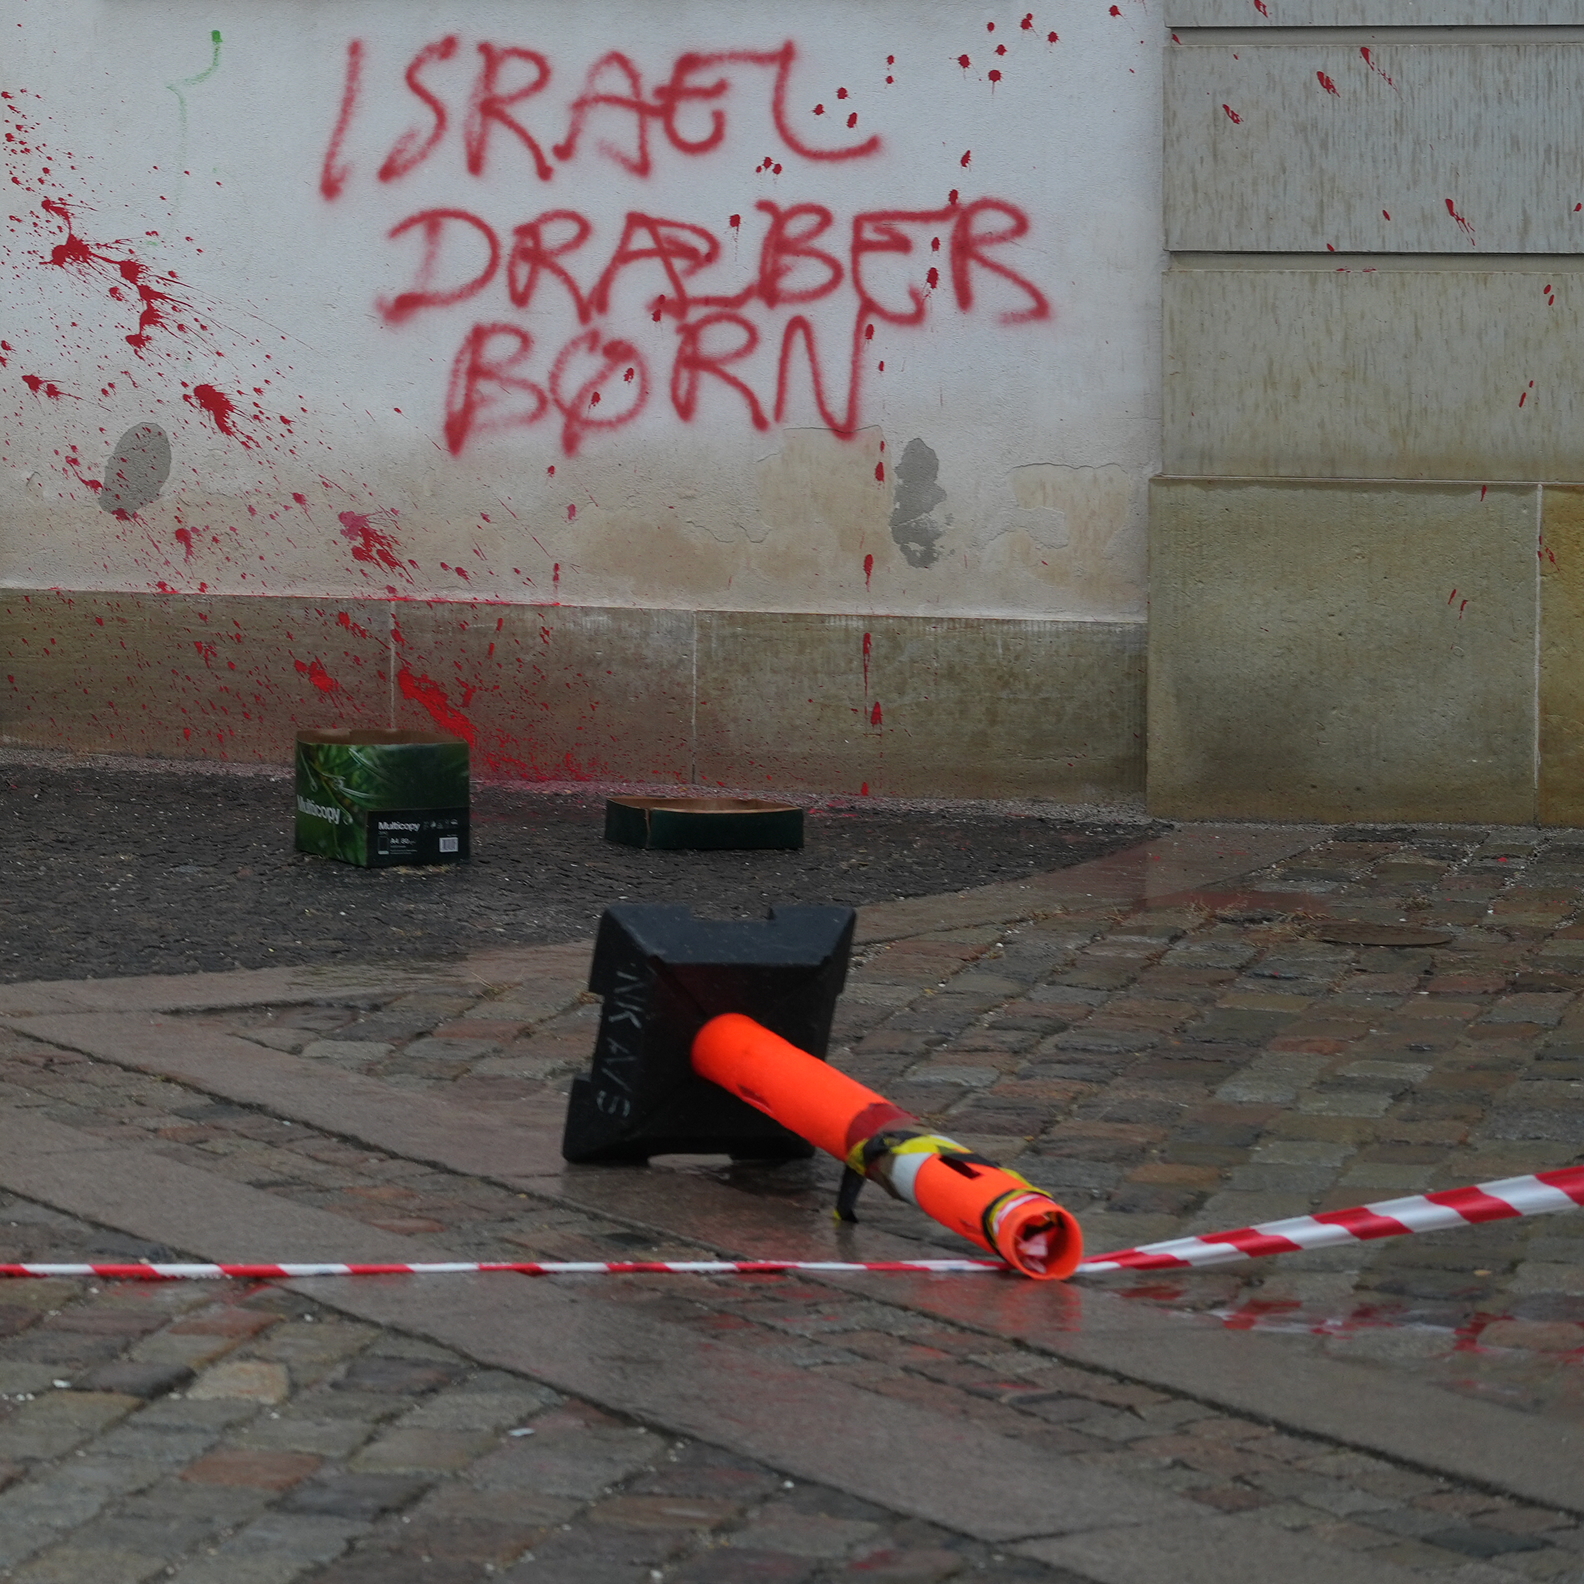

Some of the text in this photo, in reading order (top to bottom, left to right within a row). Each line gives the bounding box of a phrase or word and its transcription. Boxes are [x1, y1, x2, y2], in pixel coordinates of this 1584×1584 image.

[317, 34, 882, 201] ISRAEL
[443, 304, 875, 459] BØRN
[297, 793, 341, 825] Multicopy
[378, 821, 421, 832] Multicopy
